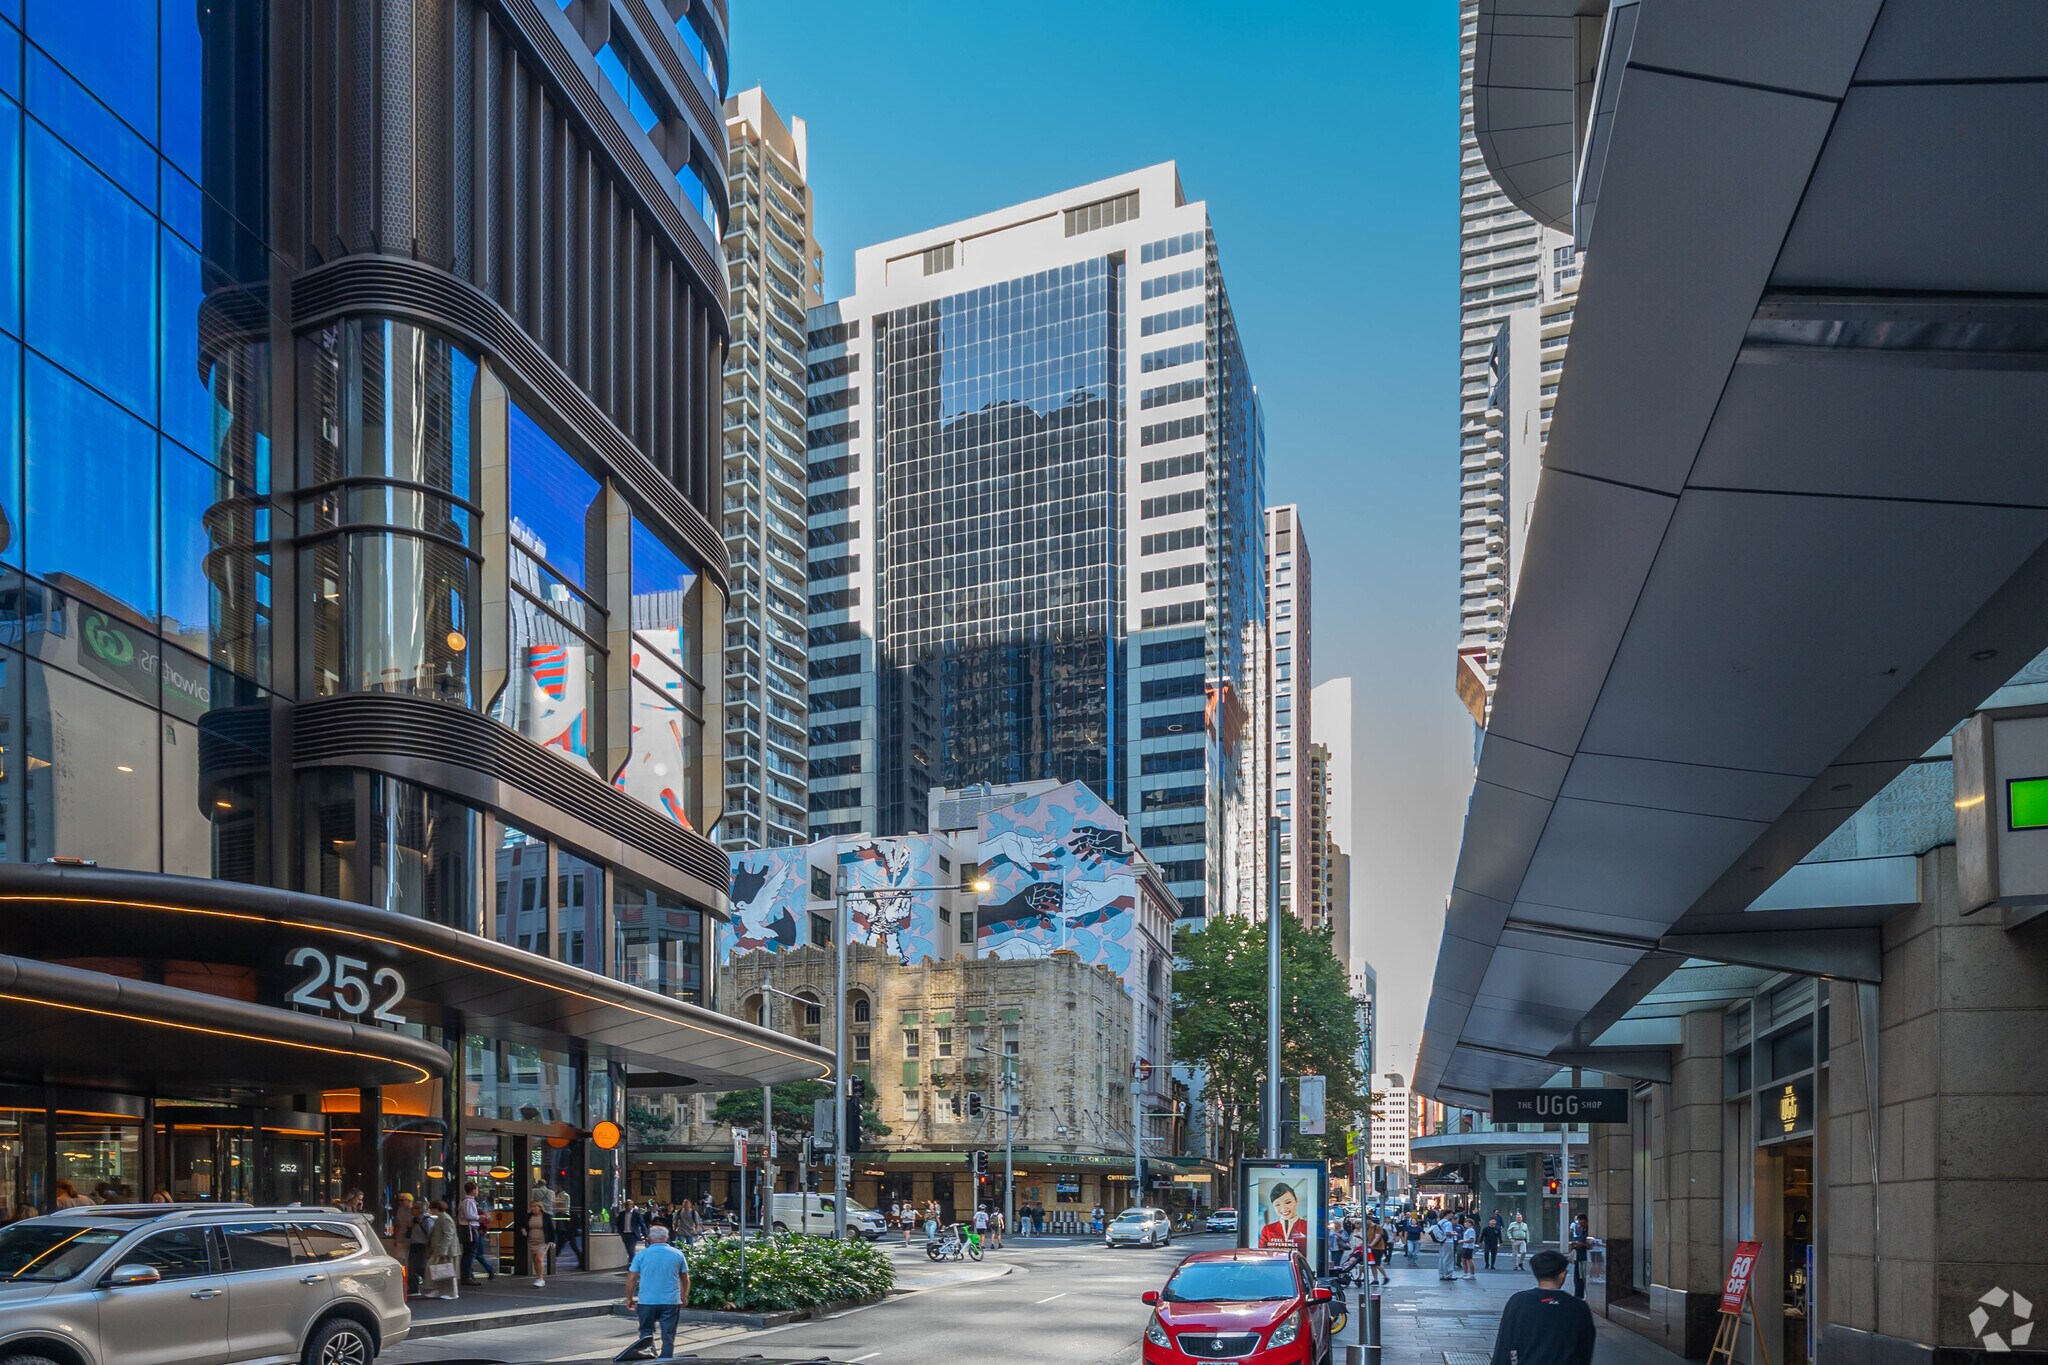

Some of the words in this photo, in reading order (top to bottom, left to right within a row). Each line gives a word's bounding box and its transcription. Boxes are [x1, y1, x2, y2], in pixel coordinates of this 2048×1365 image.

[289, 947, 406, 1024] 252
[1518, 1101, 1533, 1109] THE
[1536, 1095, 1578, 1115] UGG
[1581, 1101, 1602, 1109] SHOP
[280, 1164, 297, 1172] 252
[1727, 1278, 1746, 1294] OFF
